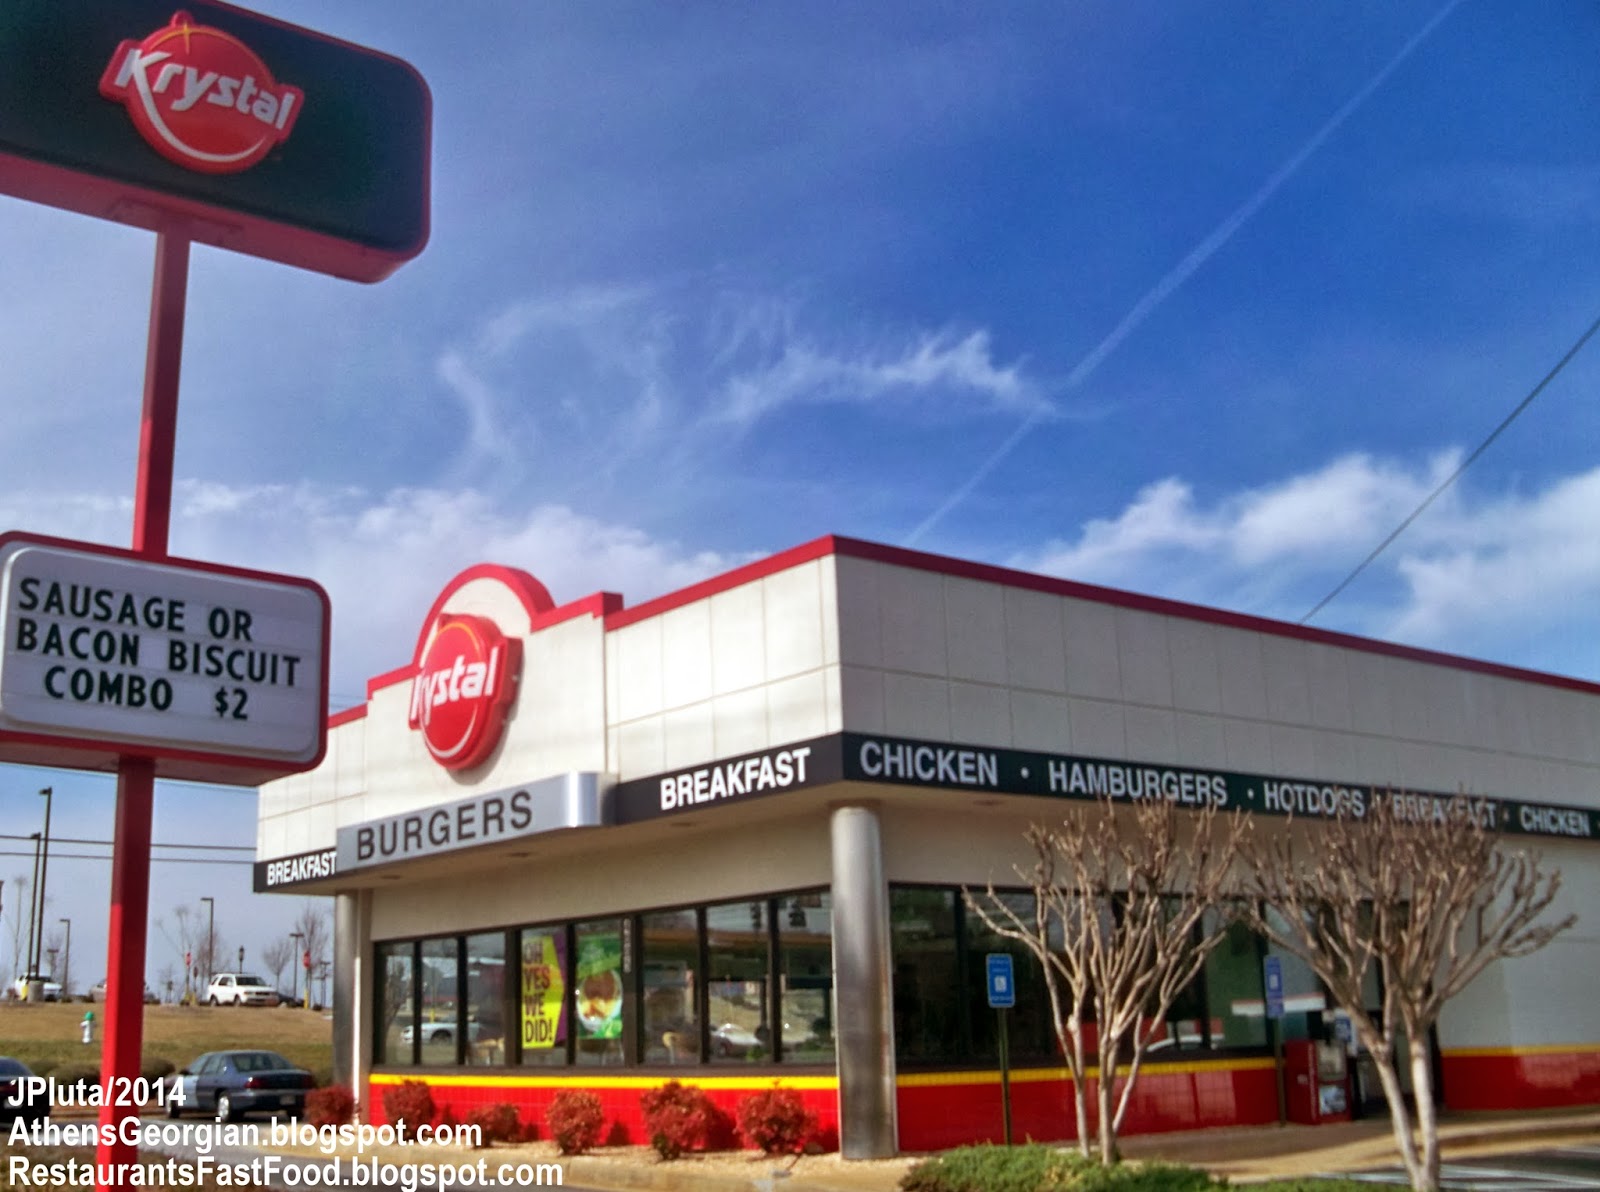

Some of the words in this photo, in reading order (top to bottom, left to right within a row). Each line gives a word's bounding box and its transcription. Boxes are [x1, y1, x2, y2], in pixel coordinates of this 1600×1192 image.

[114, 48, 296, 134] Krystal
[18, 577, 185, 632] SAUSAGE
[208, 607, 253, 642] OR
[17, 618, 139, 666] BACON
[168, 640, 300, 686] BISCUIT
[45, 666, 173, 711] COMBO
[215, 686, 249, 720] $2
[660, 747, 812, 811] BREAKFAST
[860, 741, 999, 787] CHICKEN
[1048, 760, 1228, 806] HAMBURGERS
[1520, 804, 1592, 837] CHICKEN
[356, 790, 533, 861] BURGERS
[266, 851, 337, 886] BREAKFAST
[524, 966, 551, 992] YES
[525, 1017, 553, 1043] DID!
